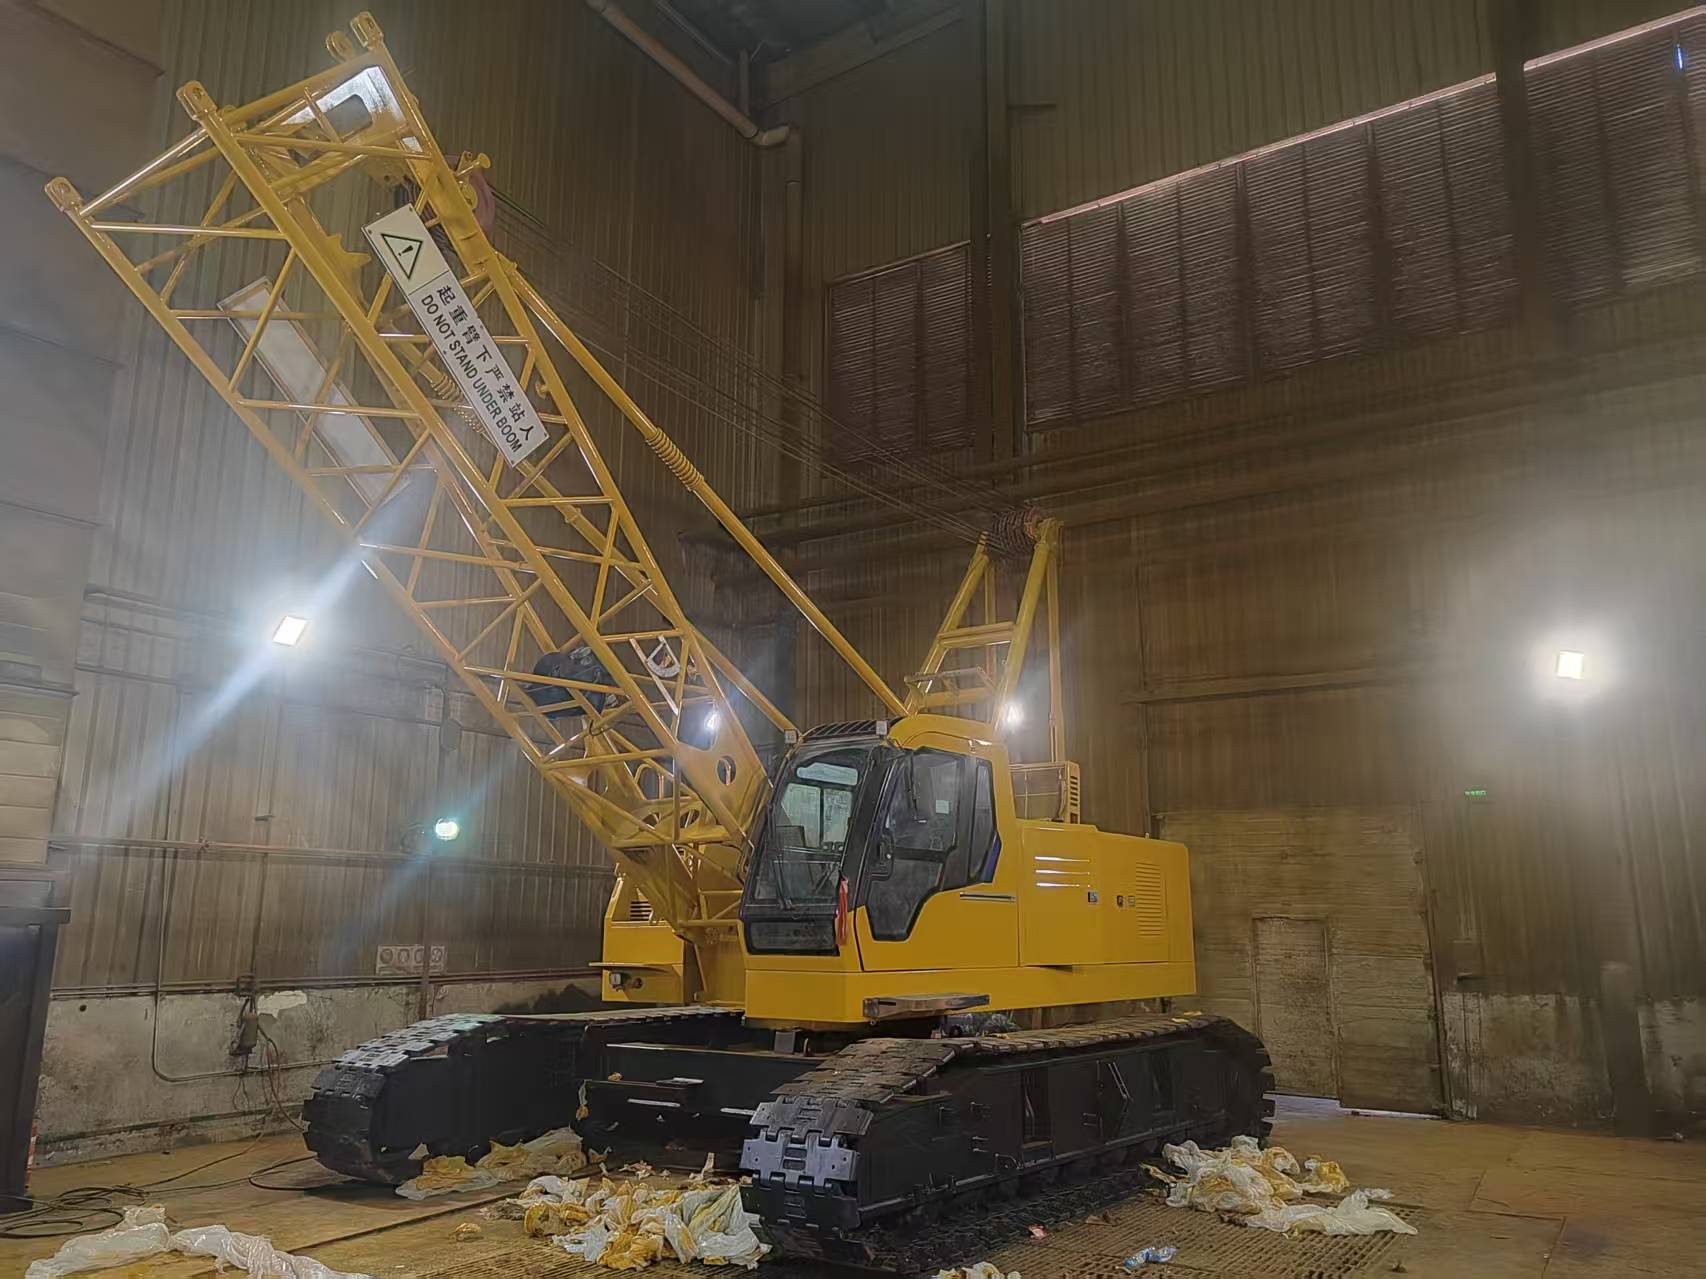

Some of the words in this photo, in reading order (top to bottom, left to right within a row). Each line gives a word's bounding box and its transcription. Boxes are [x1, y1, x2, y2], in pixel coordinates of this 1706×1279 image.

[420, 294, 438, 314] DO
[433, 314, 455, 341] NOT
[449, 340, 477, 378] STAND
[473, 378, 500, 419] UNDER
[496, 416, 523, 453] BOOM
[436, 284, 534, 440] 起重臂下严禁站人
